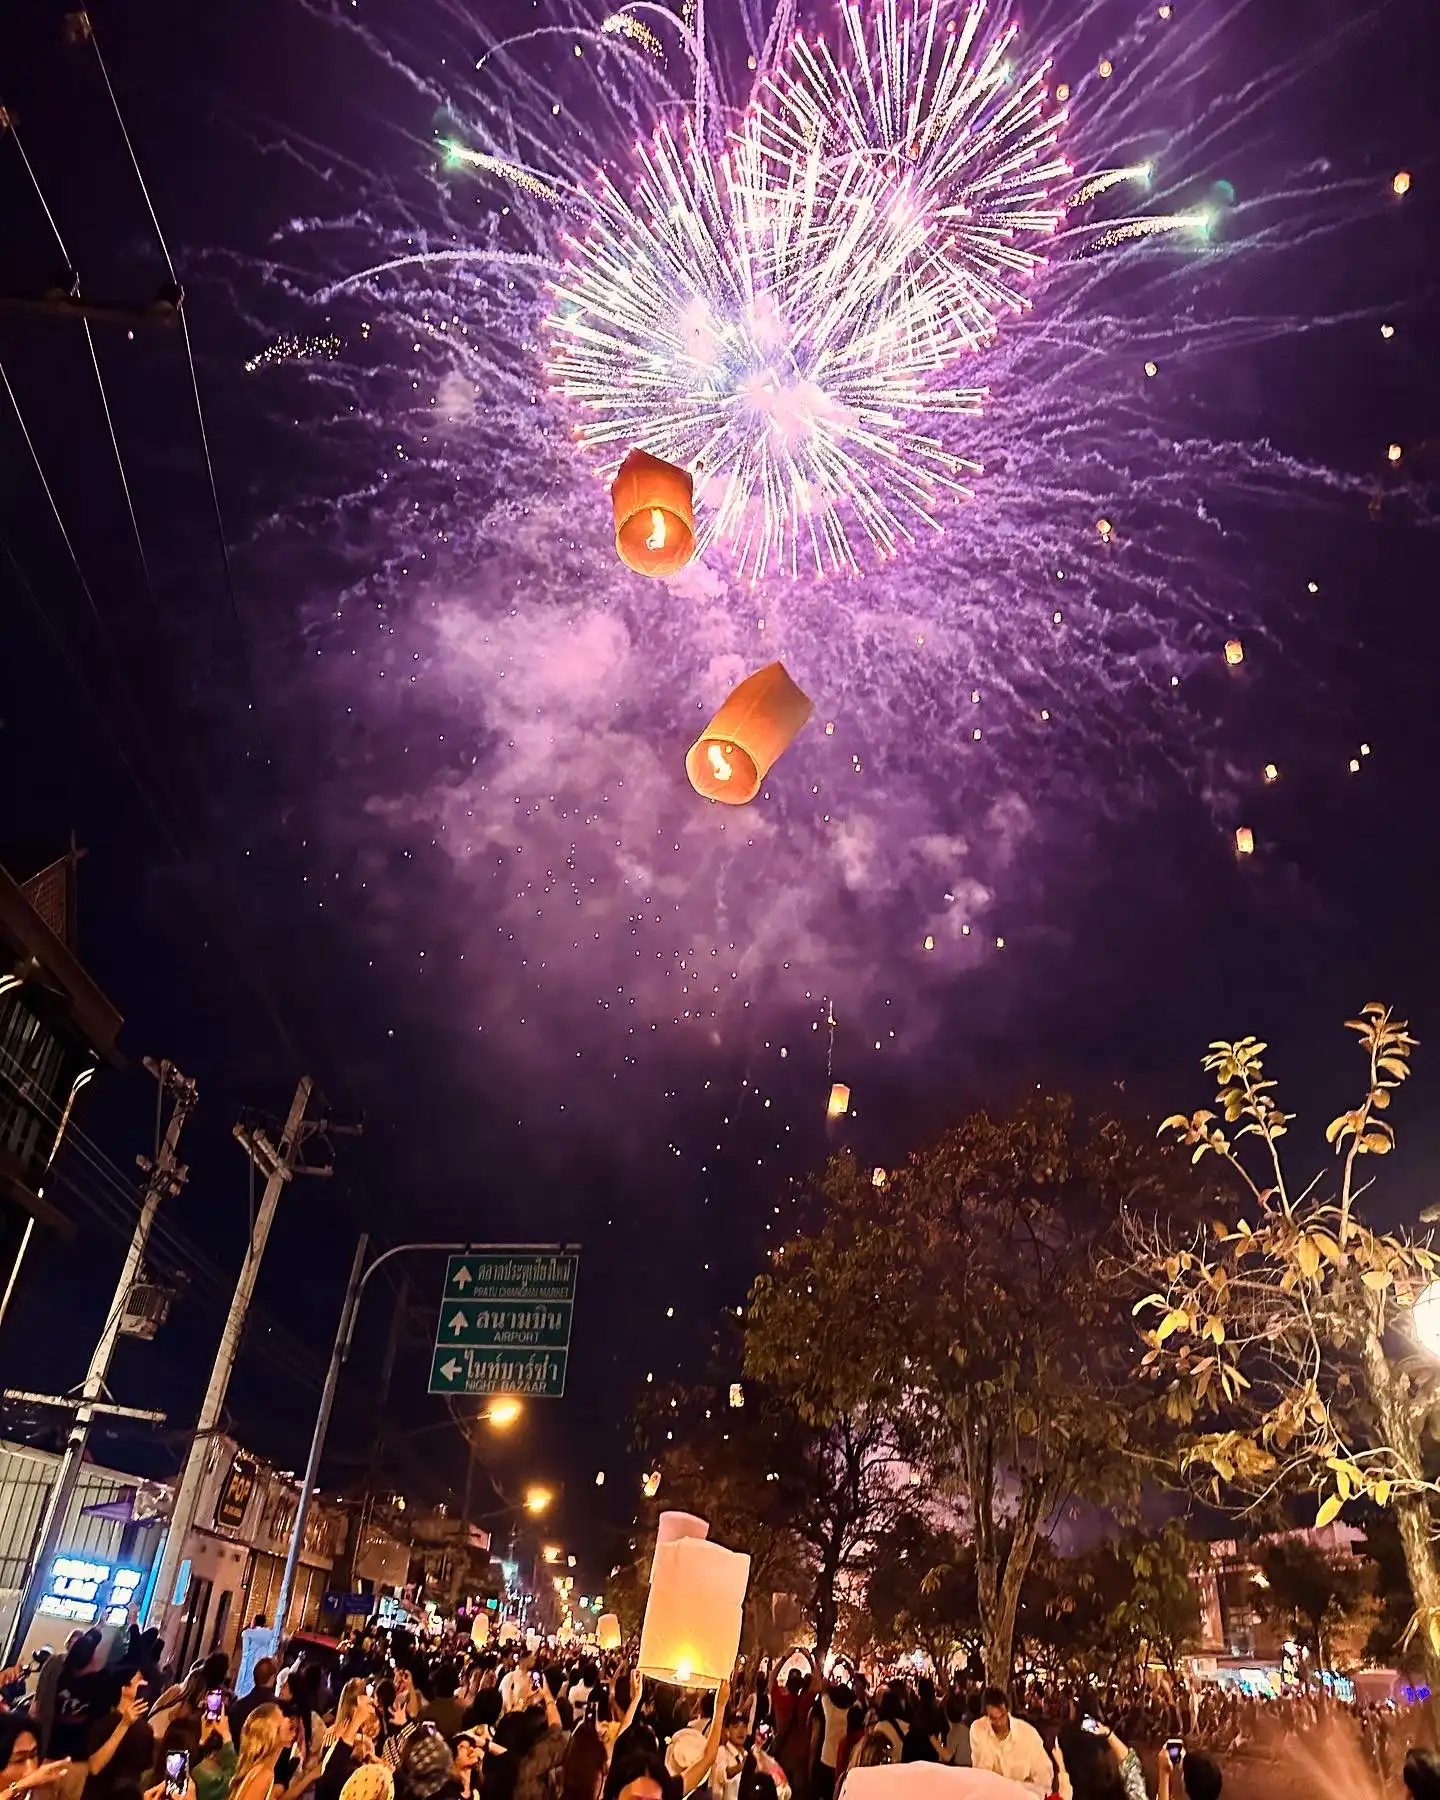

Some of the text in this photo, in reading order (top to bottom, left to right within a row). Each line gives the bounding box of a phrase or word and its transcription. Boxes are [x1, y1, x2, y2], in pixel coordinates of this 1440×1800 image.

[473, 1286, 498, 1297] PRATU
[540, 1287, 569, 1299] MARKET
[476, 1304, 562, 1331] สนามบิน
[493, 1331, 540, 1343] AIRPORT
[464, 1379, 547, 1393] NIGHT BAZAAR
